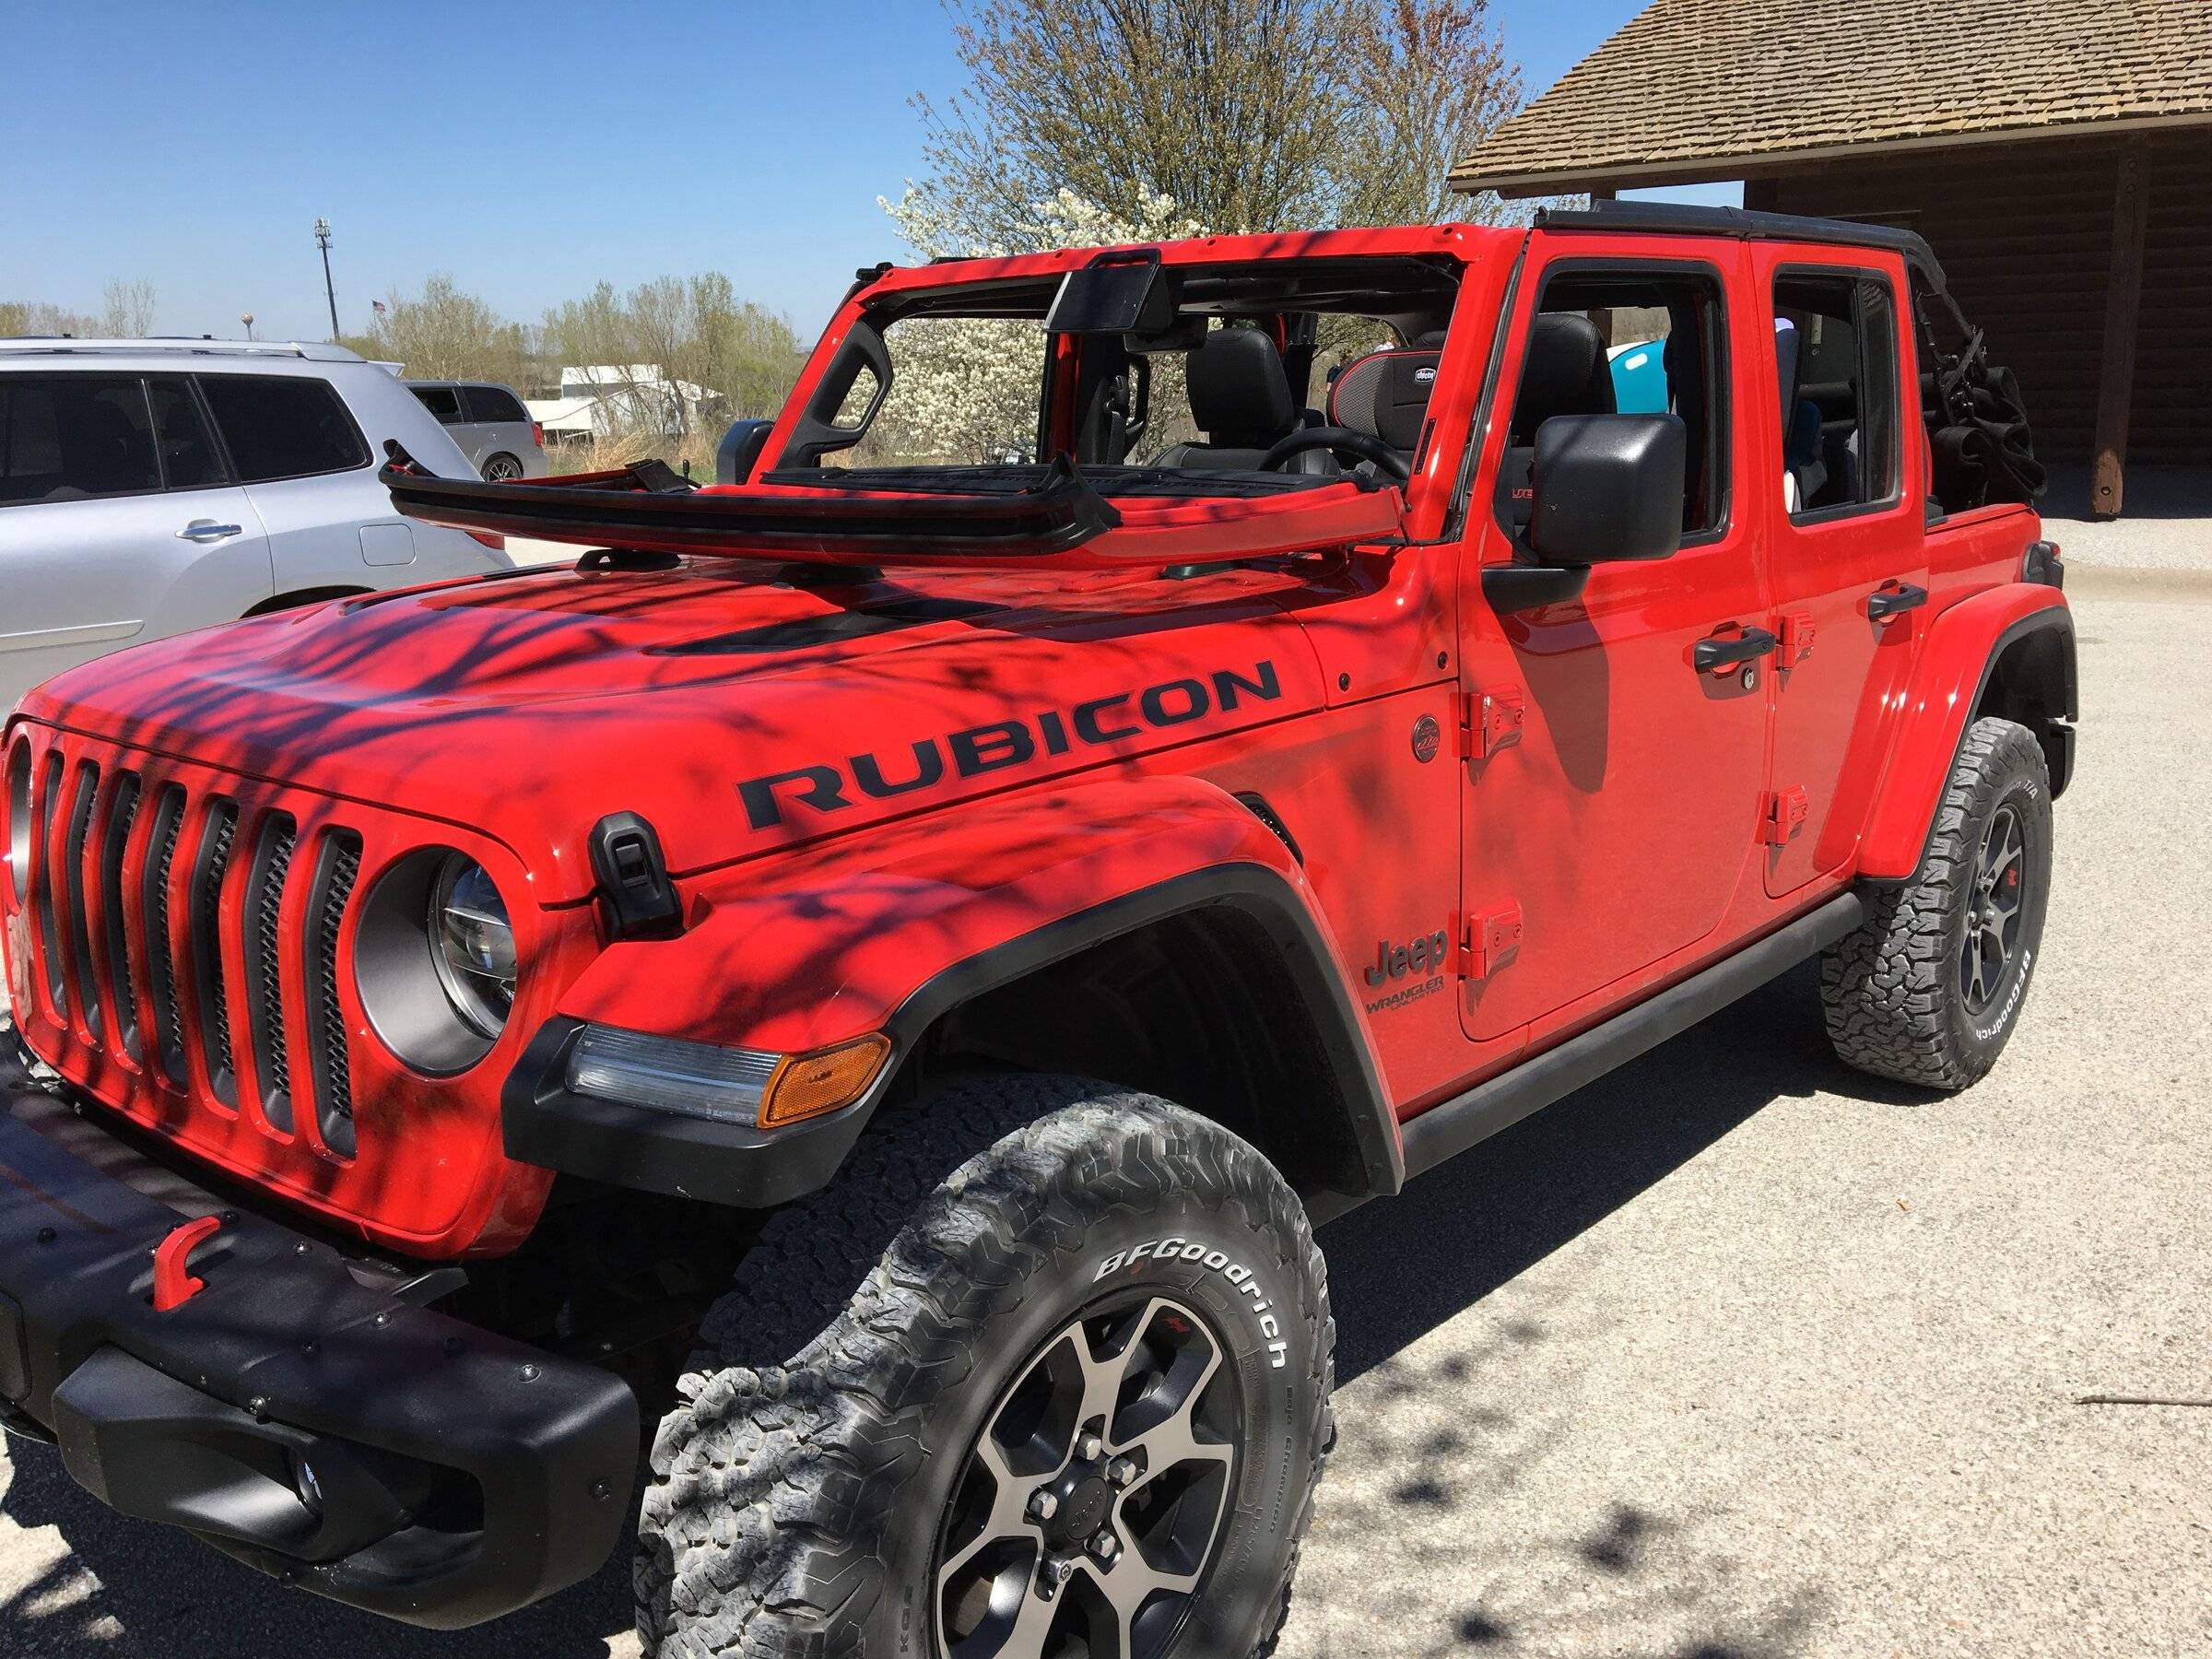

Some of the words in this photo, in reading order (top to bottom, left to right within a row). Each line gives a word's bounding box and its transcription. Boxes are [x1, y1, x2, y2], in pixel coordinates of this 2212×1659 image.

[737, 660, 1282, 830] RUBICON
[1364, 929, 1448, 987] Jeep
[1365, 975, 1444, 1015] WRANGLER
[1975, 949, 2031, 1041] BFGoodrich
[1092, 1238, 1288, 1369] BFGoodrich
